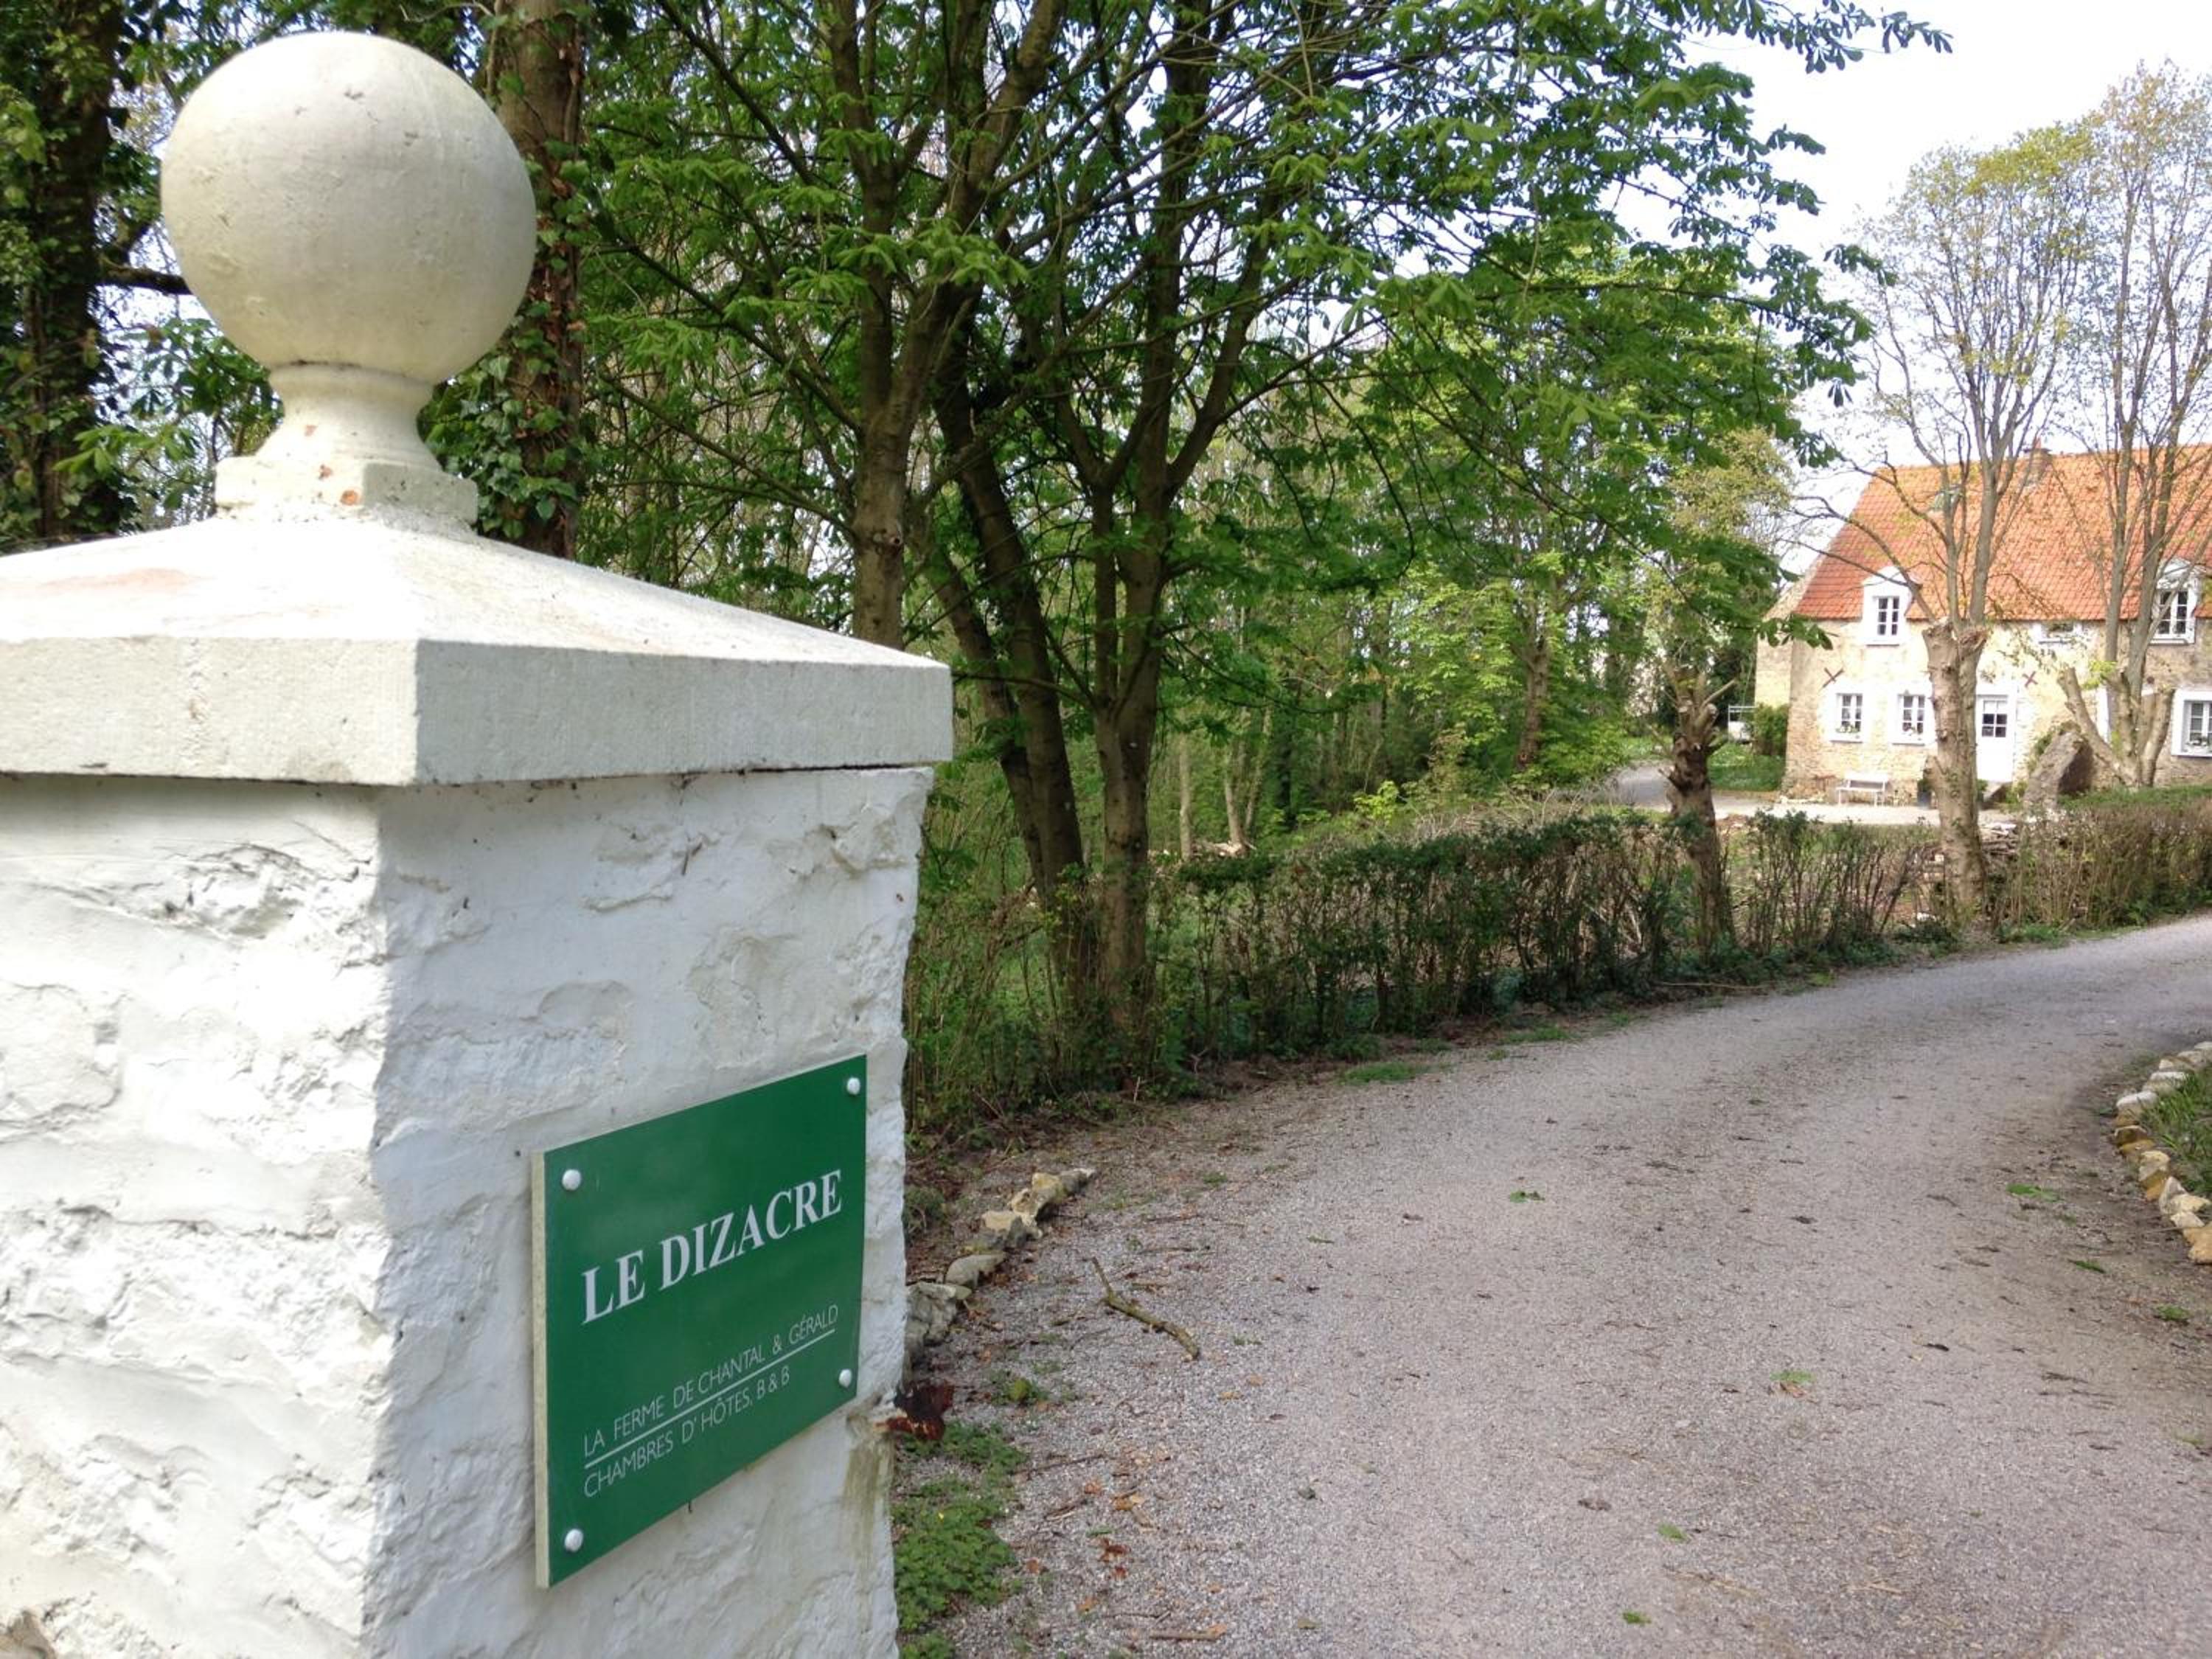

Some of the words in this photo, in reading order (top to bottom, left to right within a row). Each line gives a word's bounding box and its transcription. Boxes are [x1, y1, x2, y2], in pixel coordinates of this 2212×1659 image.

[581, 1250, 645, 1325] LE
[658, 1169, 842, 1291] DIZACRE
[583, 1429, 605, 1457] LA
[613, 1395, 664, 1440] FERME
[673, 1380, 694, 1409] DE
[698, 1344, 765, 1394] CHANTAL
[772, 1334, 782, 1354] &
[788, 1304, 838, 1345] GÉRALD
[585, 1430, 673, 1498] CHAMBRES
[756, 1379, 765, 1400] B
[768, 1374, 778, 1393] &
[781, 1366, 790, 1385] B
